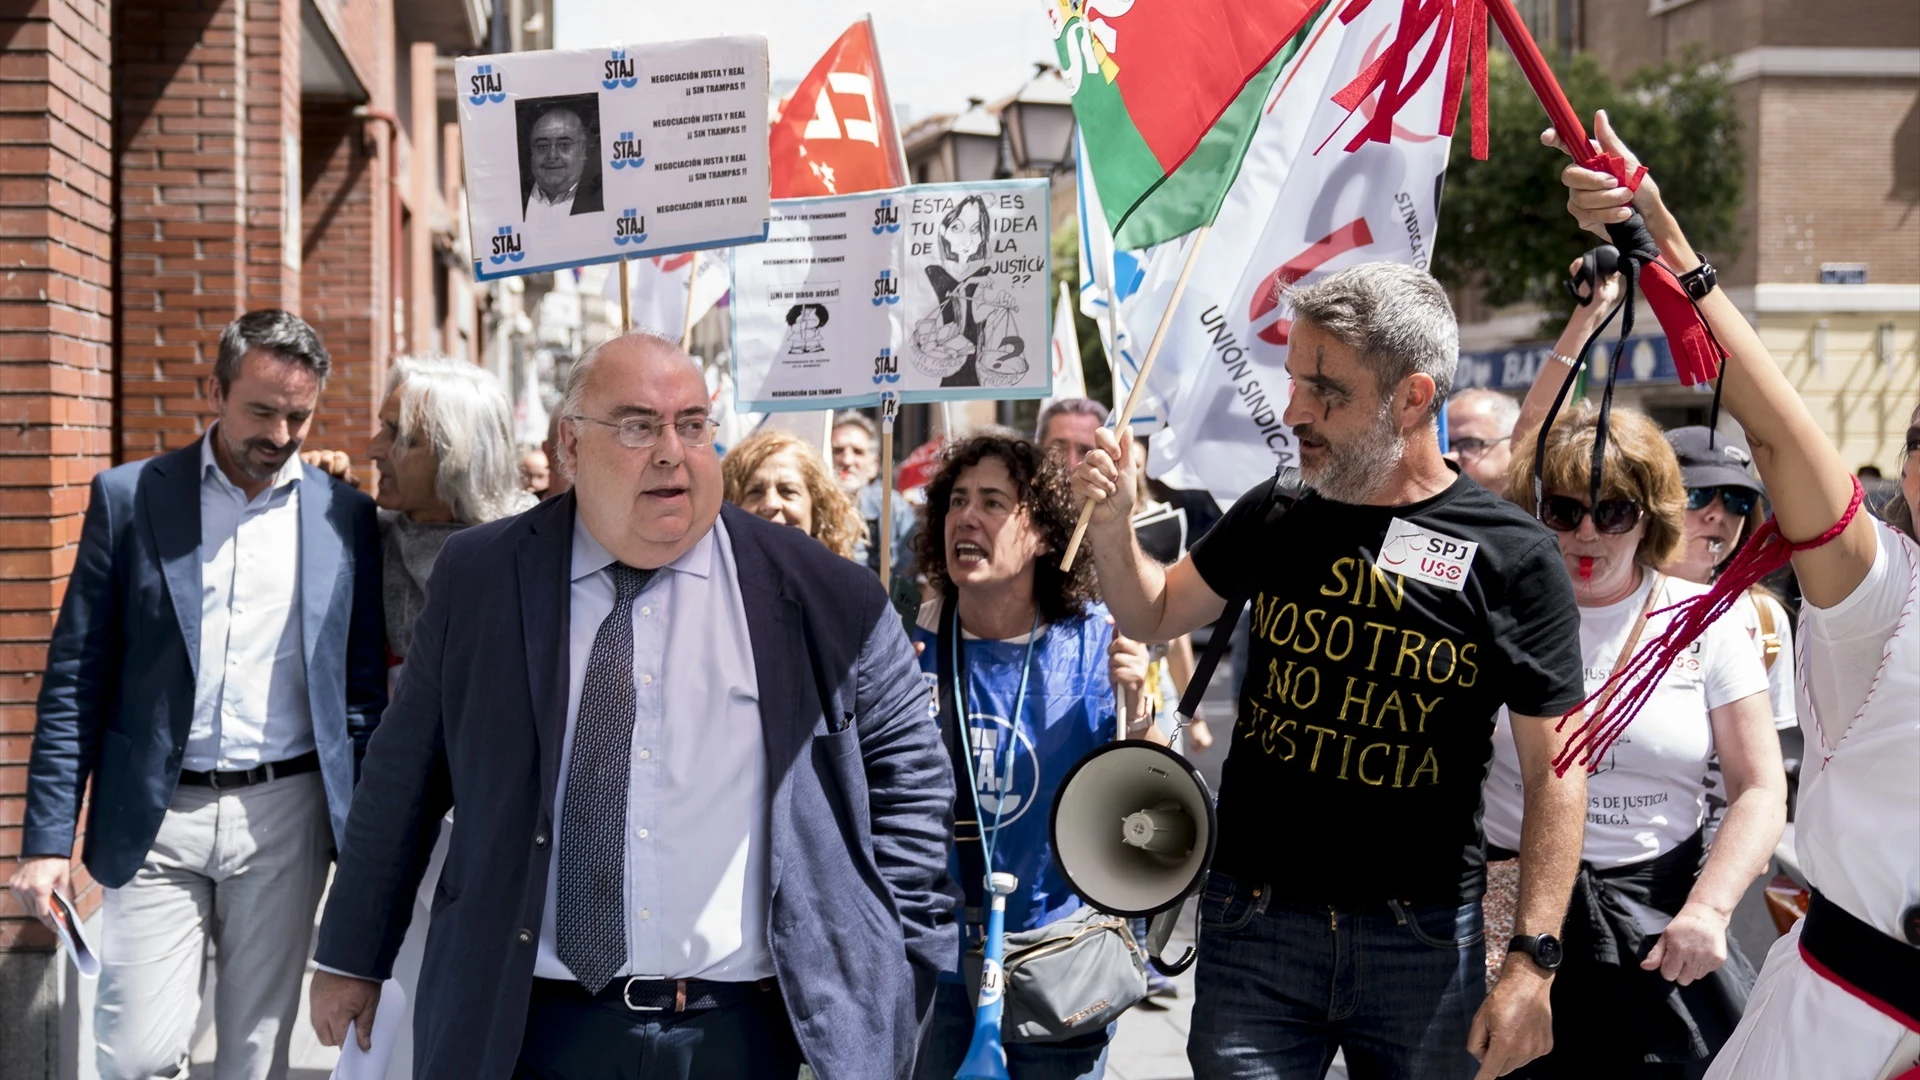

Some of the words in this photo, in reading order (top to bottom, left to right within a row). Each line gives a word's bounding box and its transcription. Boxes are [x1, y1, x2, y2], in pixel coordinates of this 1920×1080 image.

[604, 58, 635, 80] STAJ
[651, 71, 699, 83] NEGOCIACIÓN
[700, 69, 721, 79] JUSTA
[723, 68, 728, 76] Y
[728, 67, 745, 75] REAL
[471, 73, 502, 96] STAJ
[692, 86, 704, 95] SIN
[706, 82, 739, 93] TRAMPAS
[653, 115, 700, 128] NEGOCIACIÓN
[702, 113, 722, 123] JUSTA
[724, 112, 728, 120] Y
[729, 111, 746, 120] REAL
[694, 130, 706, 139] SIN
[707, 126, 740, 137] TRAMPAS
[613, 139, 642, 160] STAJ
[655, 158, 701, 171] NEGOCIACIÓN
[703, 156, 724, 166] JUSTA
[725, 155, 729, 163] Y
[730, 154, 747, 163] REAL
[695, 173, 707, 181] SIN
[708, 169, 741, 180] TRAMPAS
[657, 201, 702, 213] NEGOCIACIÓN
[704, 198, 725, 208] JUSTA
[725, 197, 730, 205] Y
[731, 196, 748, 204] REAL
[912, 197, 955, 214] ESTA
[1000, 195, 1024, 209] ES
[809, 211, 847, 220] FUNCIONARIOS
[874, 206, 899, 226] STAJ
[616, 216, 645, 236] STAJ
[911, 222, 934, 236] TU
[994, 215, 1038, 233] IDEA
[1394, 192, 1428, 270] SINDICATO
[491, 233, 522, 255] STAJ
[911, 242, 933, 256] DE
[994, 238, 1018, 253] LA
[817, 255, 845, 264] FUNCIONES
[874, 278, 898, 297] STAJ
[875, 356, 898, 375] STAJ
[771, 389, 808, 398] NEGOCIACIÓN
[819, 388, 842, 396] TRAMPAS
[1200, 304, 1254, 382] UNIÓN
[1238, 380, 1295, 467] SINDICA
[1427, 537, 1468, 560] SPJ
[1420, 557, 1462, 580] USO
[1320, 556, 1405, 612] SIN
[1251, 591, 1478, 688] NOSOTROS
[1677, 656, 1700, 671] SO
[1263, 657, 1321, 710] NO
[1336, 676, 1444, 733] HAY
[1239, 697, 1440, 788] JUSTICIA
[1603, 796, 1620, 808] DE
[1622, 792, 1668, 811] JUSTICIA
[1587, 813, 1630, 826] UELGA
